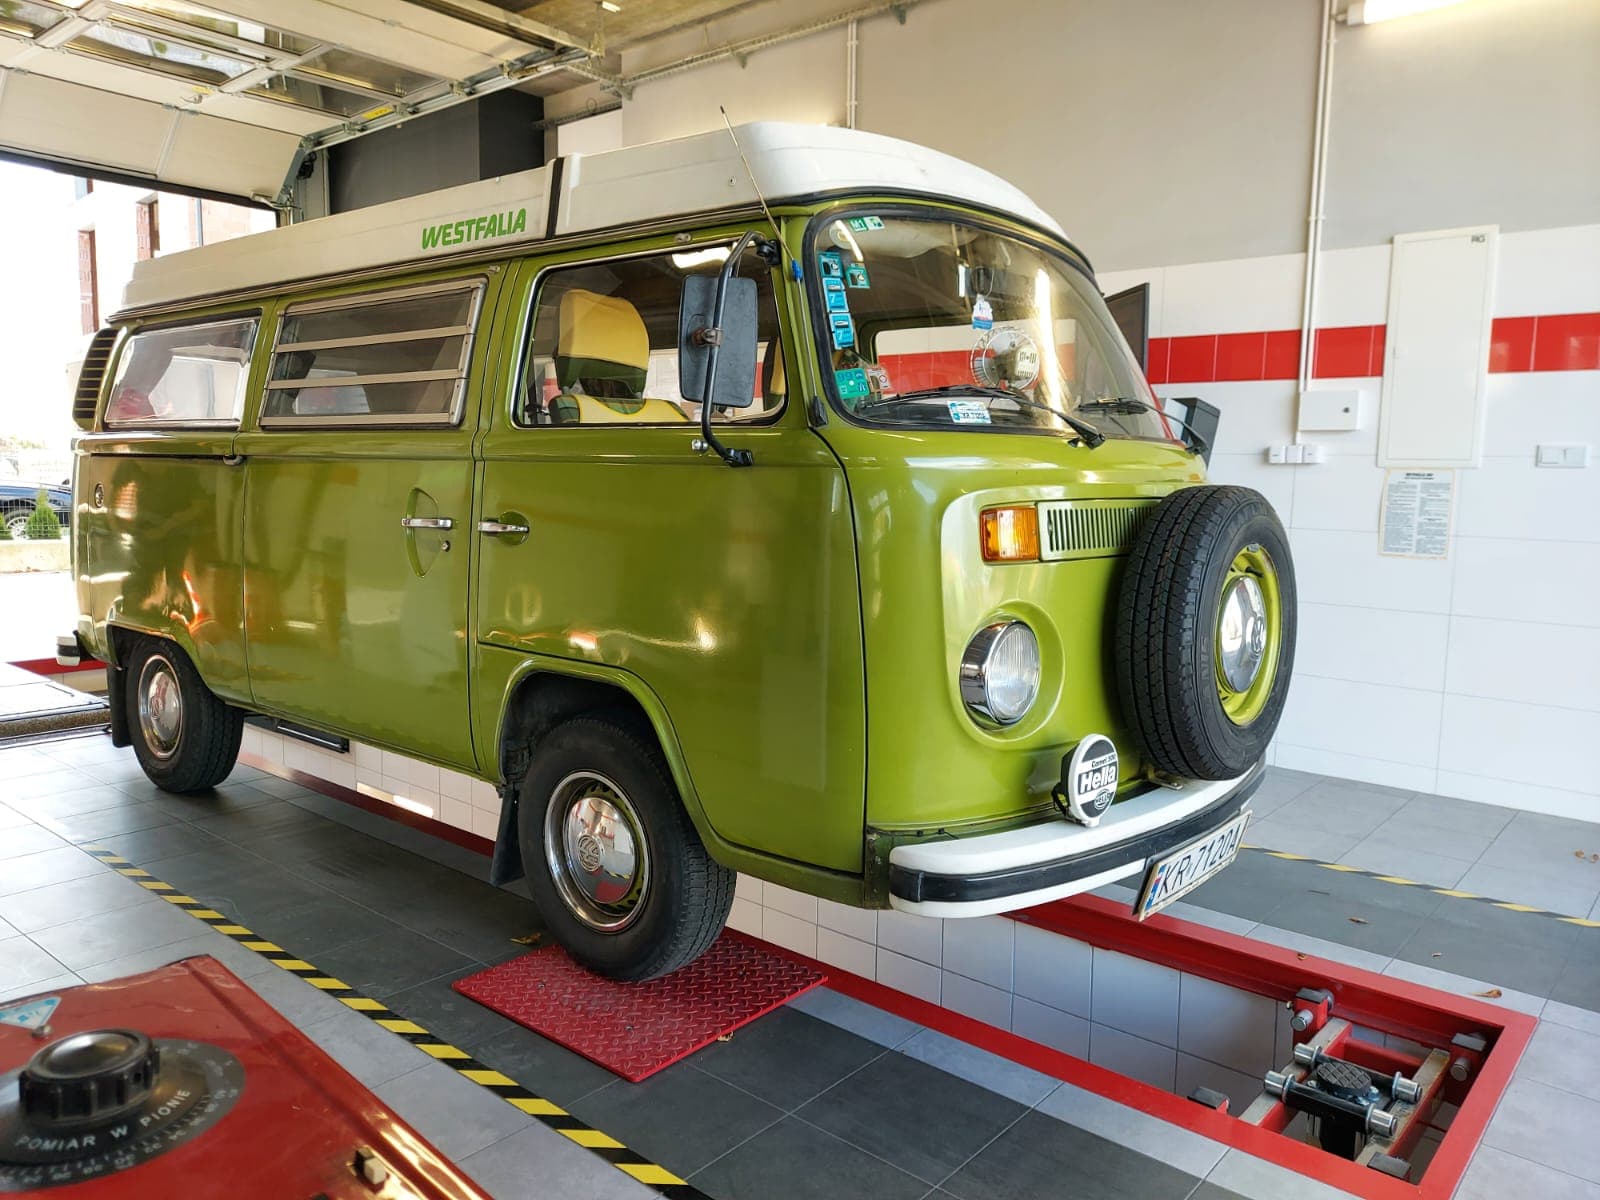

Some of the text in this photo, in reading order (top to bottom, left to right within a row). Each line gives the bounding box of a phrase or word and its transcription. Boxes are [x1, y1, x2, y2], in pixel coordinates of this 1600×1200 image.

[422, 208, 526, 249] WESTFALIA
[1080, 766, 1116, 794] Hella
[1158, 823, 1241, 898] KR 7120A
[15, 1135, 96, 1151] POMIAR
[110, 1125, 128, 1138] W
[139, 1089, 191, 1127] PIONIE
